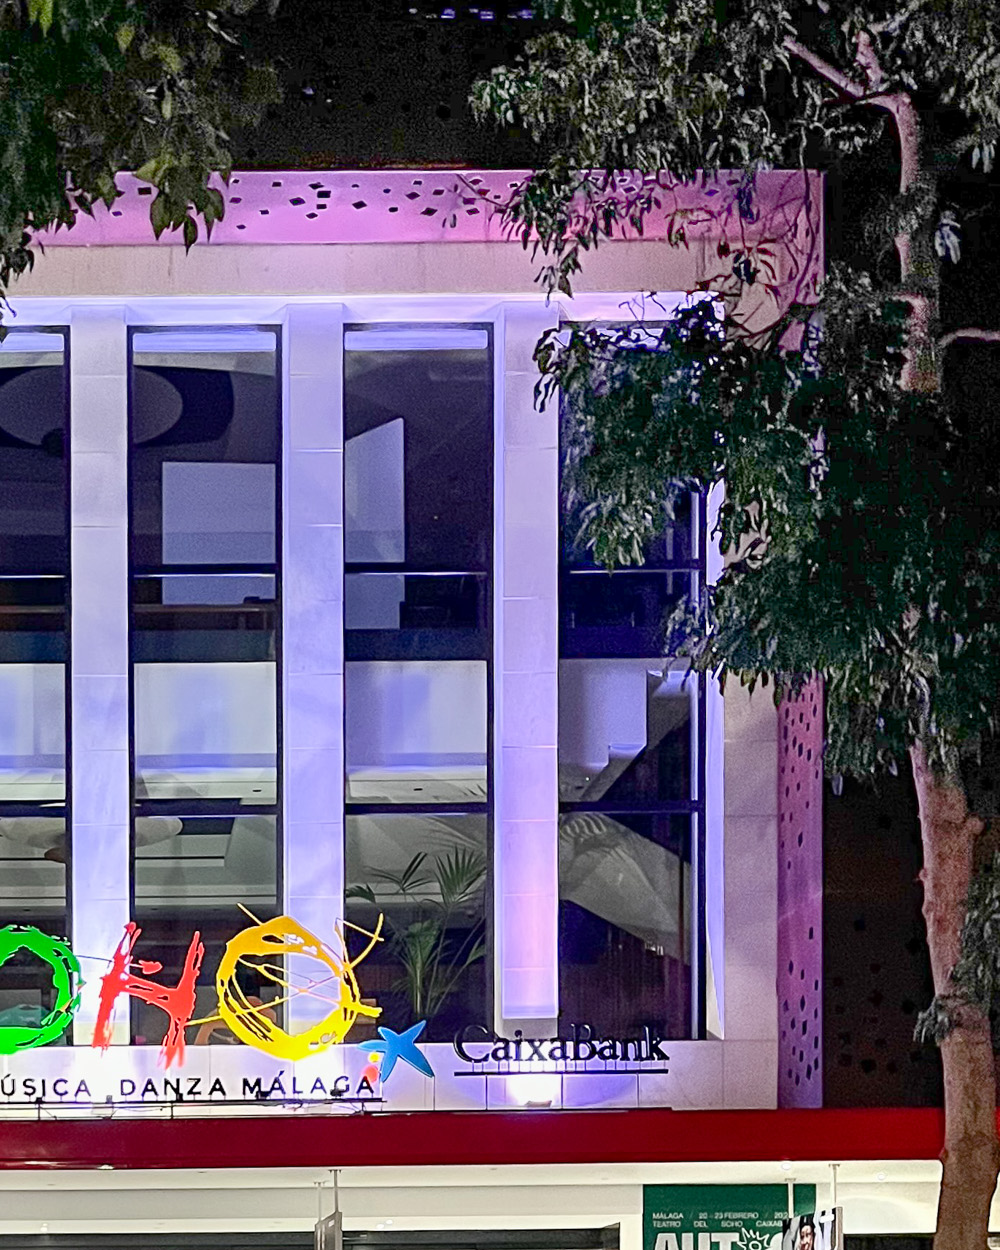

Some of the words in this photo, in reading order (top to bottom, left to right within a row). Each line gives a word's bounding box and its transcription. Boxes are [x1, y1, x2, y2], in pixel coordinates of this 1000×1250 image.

[453, 1024, 670, 1062] CaixaBank
[121, 1078, 227, 1097] DANZA
[242, 1070, 375, 1097] MÁLAGA
[652, 1211, 684, 1219] MÁLAGA
